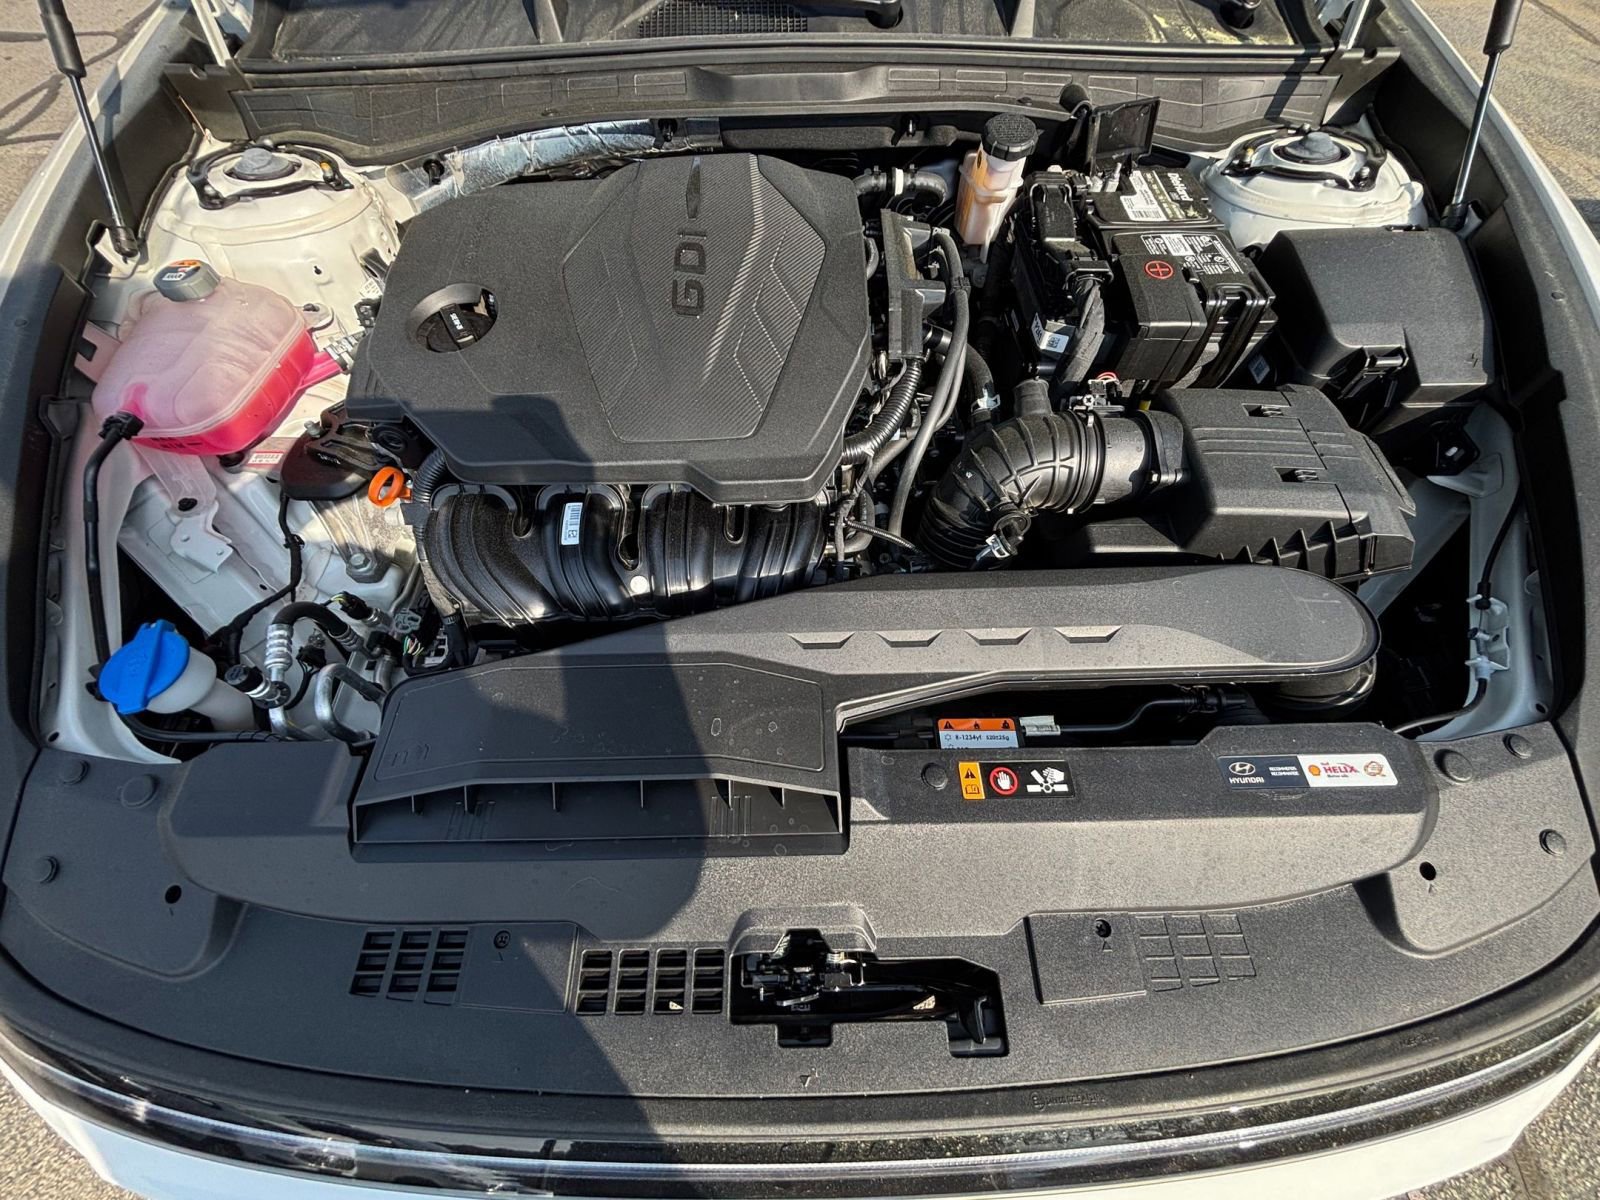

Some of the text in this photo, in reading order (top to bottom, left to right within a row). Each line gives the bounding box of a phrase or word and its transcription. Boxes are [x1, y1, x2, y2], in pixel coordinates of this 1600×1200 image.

[1167, 172, 1194, 202] DieHard
[1323, 766, 1358, 774] HELIX
[1228, 776, 1265, 784] HYUNDAI
